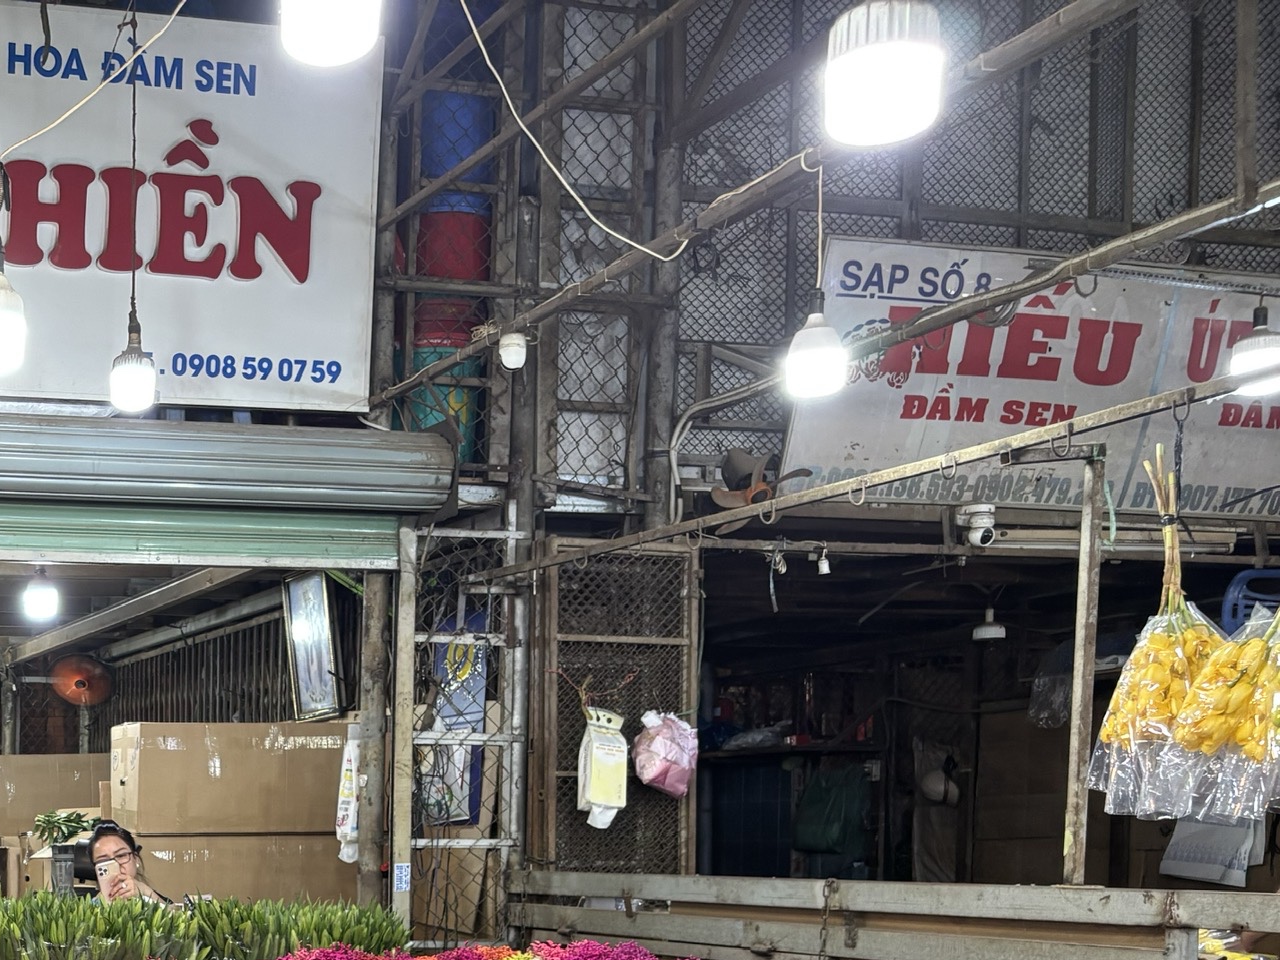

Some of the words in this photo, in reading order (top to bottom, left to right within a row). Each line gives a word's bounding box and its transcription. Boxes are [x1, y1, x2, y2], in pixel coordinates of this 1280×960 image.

[7, 42, 88, 81] HOA
[194, 60, 257, 97] SEN
[3, 118, 322, 285] HIỀN
[918, 258, 969, 300] SỐ
[899, 382, 990, 424] ĐẦM
[998, 399, 1078, 427] SEN
